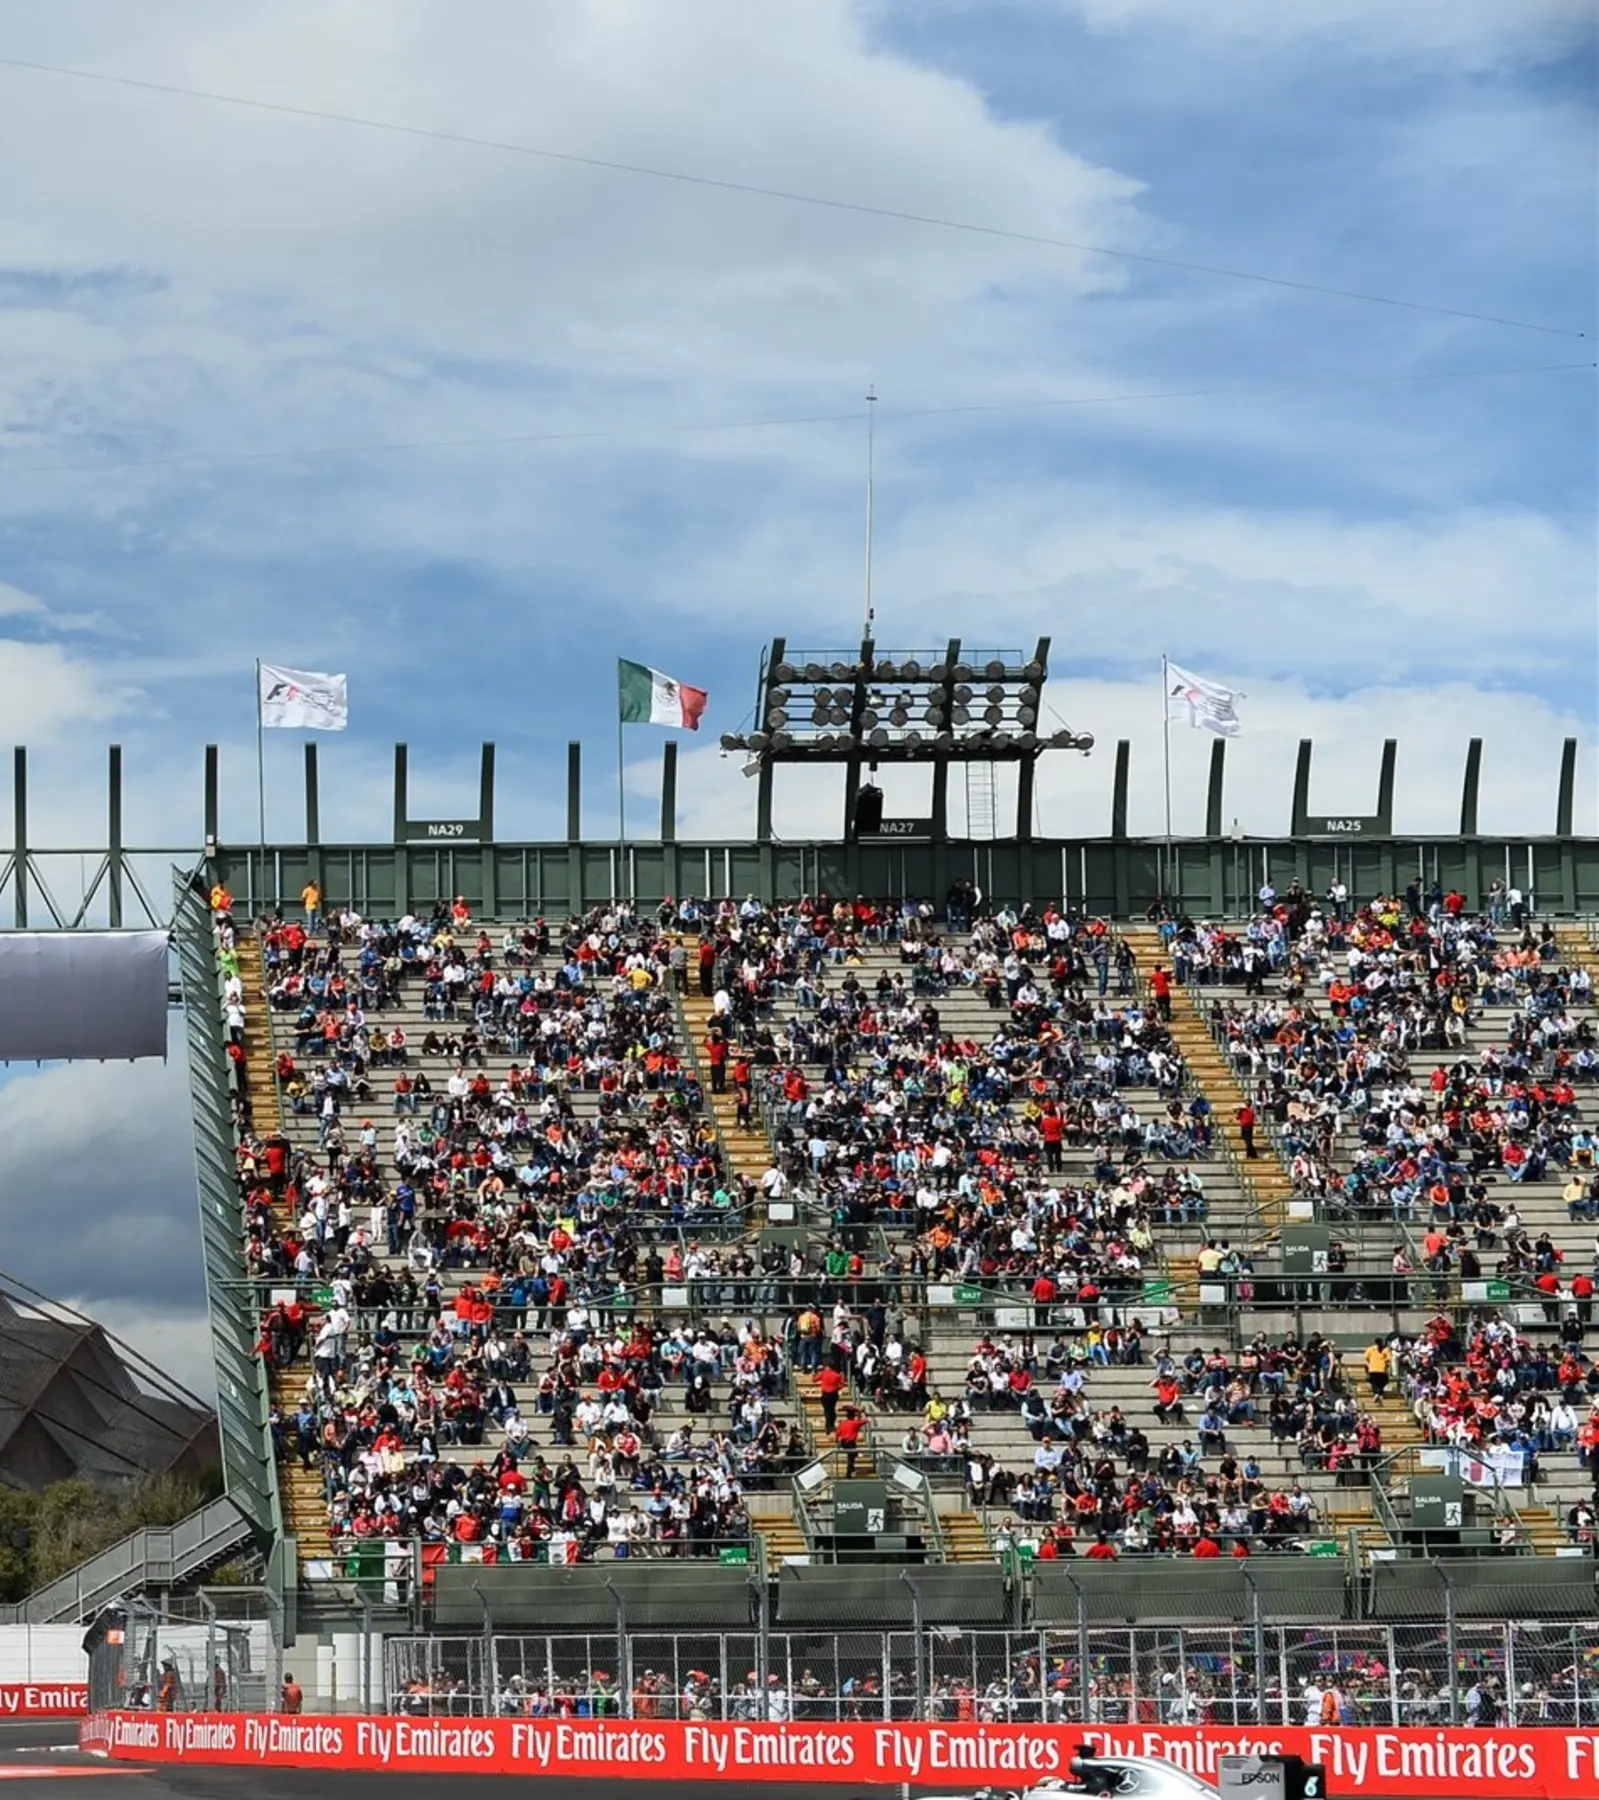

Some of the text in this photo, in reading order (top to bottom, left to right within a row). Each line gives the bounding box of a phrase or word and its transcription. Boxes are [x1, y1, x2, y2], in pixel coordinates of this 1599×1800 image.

[427, 824, 464, 836] NA29
[879, 822, 915, 833] NA27
[1326, 819, 1362, 831] NA25
[1414, 1495, 1442, 1503] SALIDA
[25, 1685, 88, 1709] Emira
[115, 1716, 159, 1748] Emirates
[166, 1718, 236, 1755] Fly Emirates
[244, 1718, 343, 1758] Fly Emirates
[357, 1721, 496, 1762] Fly Emirates
[511, 1723, 666, 1767] Fly Emirates
[685, 1725, 855, 1771] Fly Emirates
[875, 1727, 1060, 1775] Fly Emirates
[1142, 1731, 1284, 1775] Emirates
[1310, 1732, 1536, 1785] Fly Emirates
[1565, 1736, 1599, 1780] Fl
[1241, 1772, 1280, 1784] EPSON
[1304, 1776, 1319, 1797] 6
